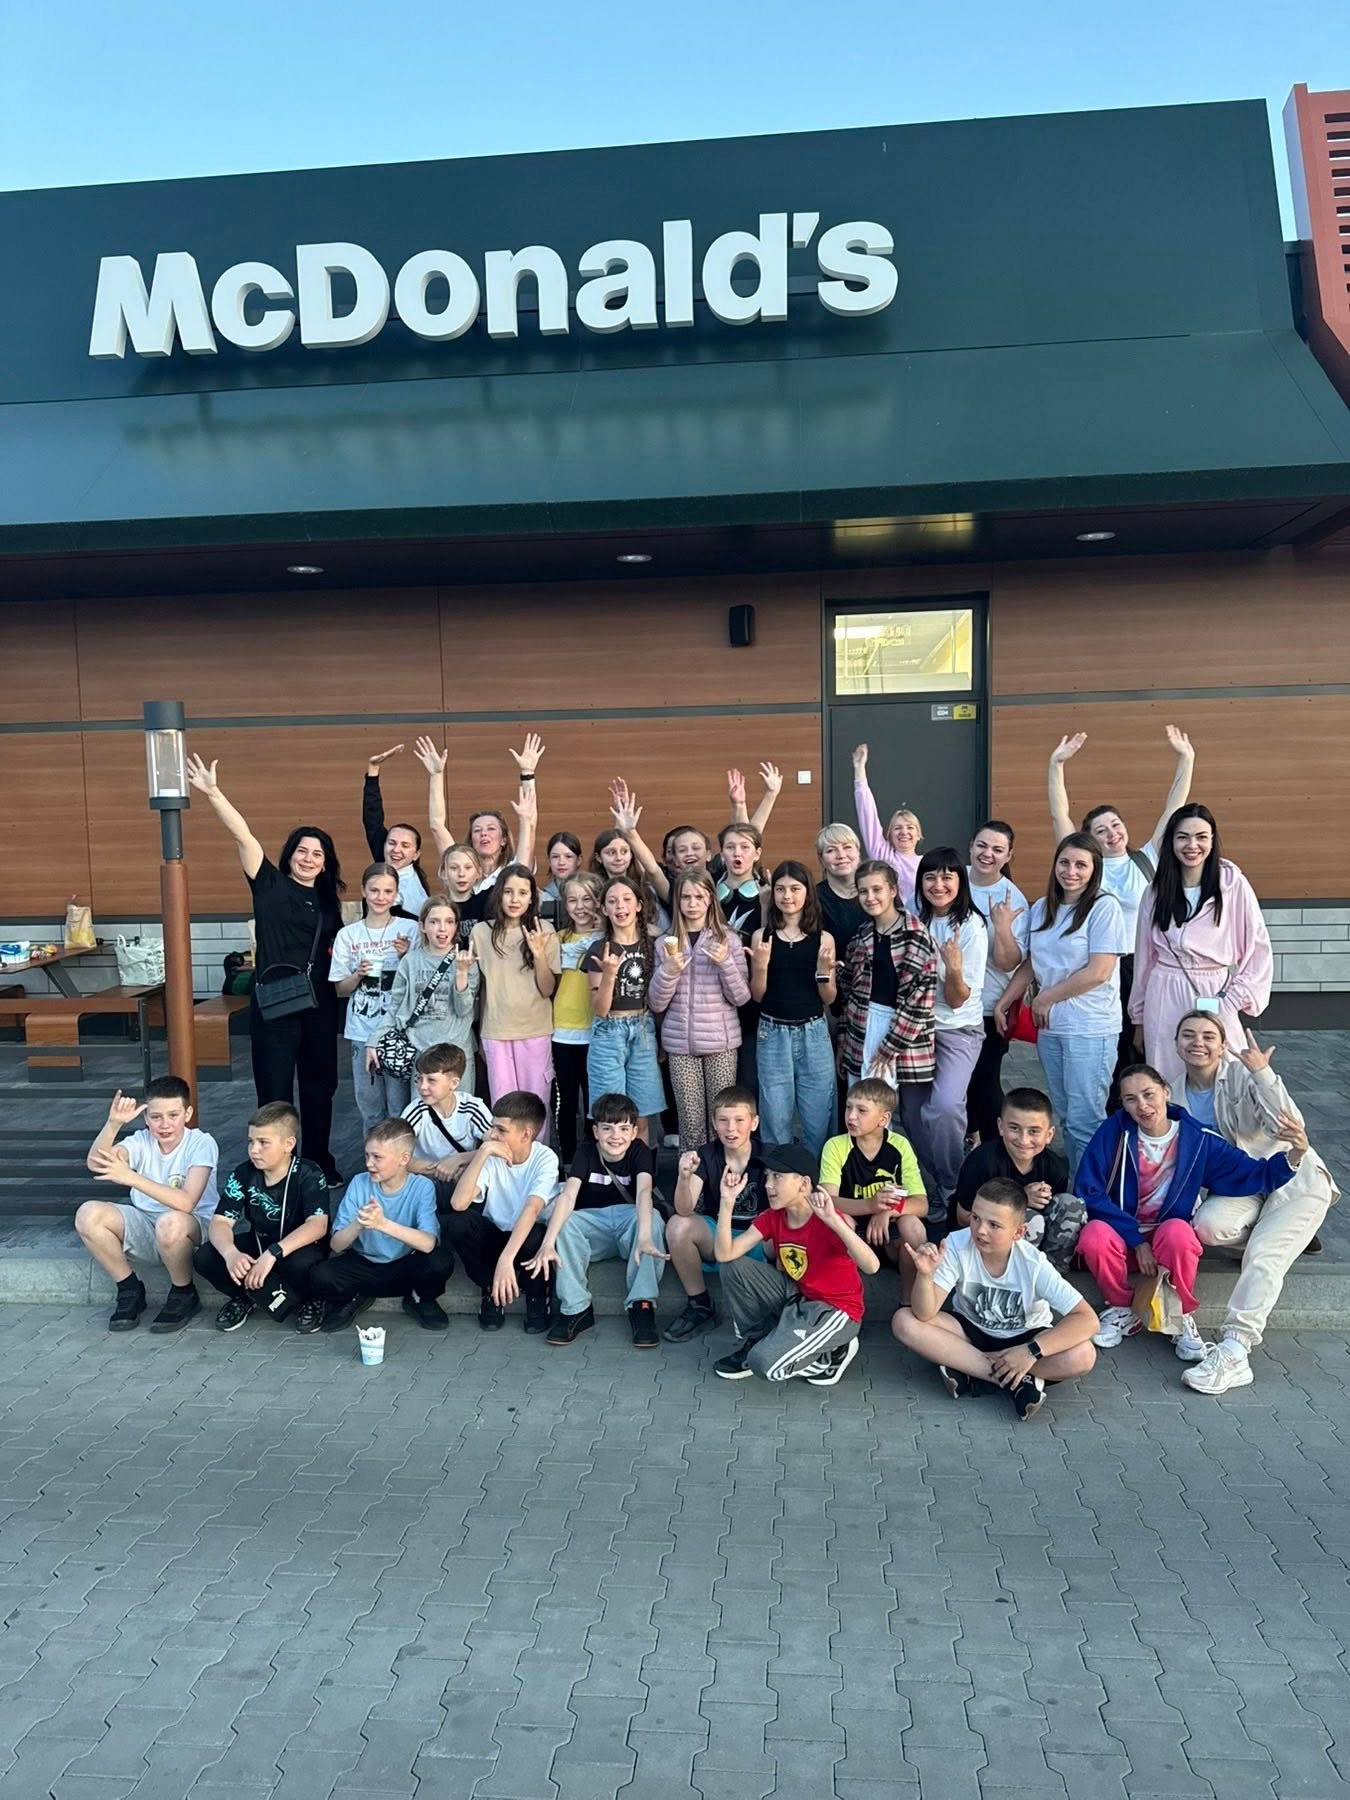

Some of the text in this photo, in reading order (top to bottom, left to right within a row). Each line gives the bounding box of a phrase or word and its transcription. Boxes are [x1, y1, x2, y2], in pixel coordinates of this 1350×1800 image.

[88, 212, 898, 359] McDonald's
[428, 970, 444, 990] PINK
[414, 995, 429, 1016] PINK
